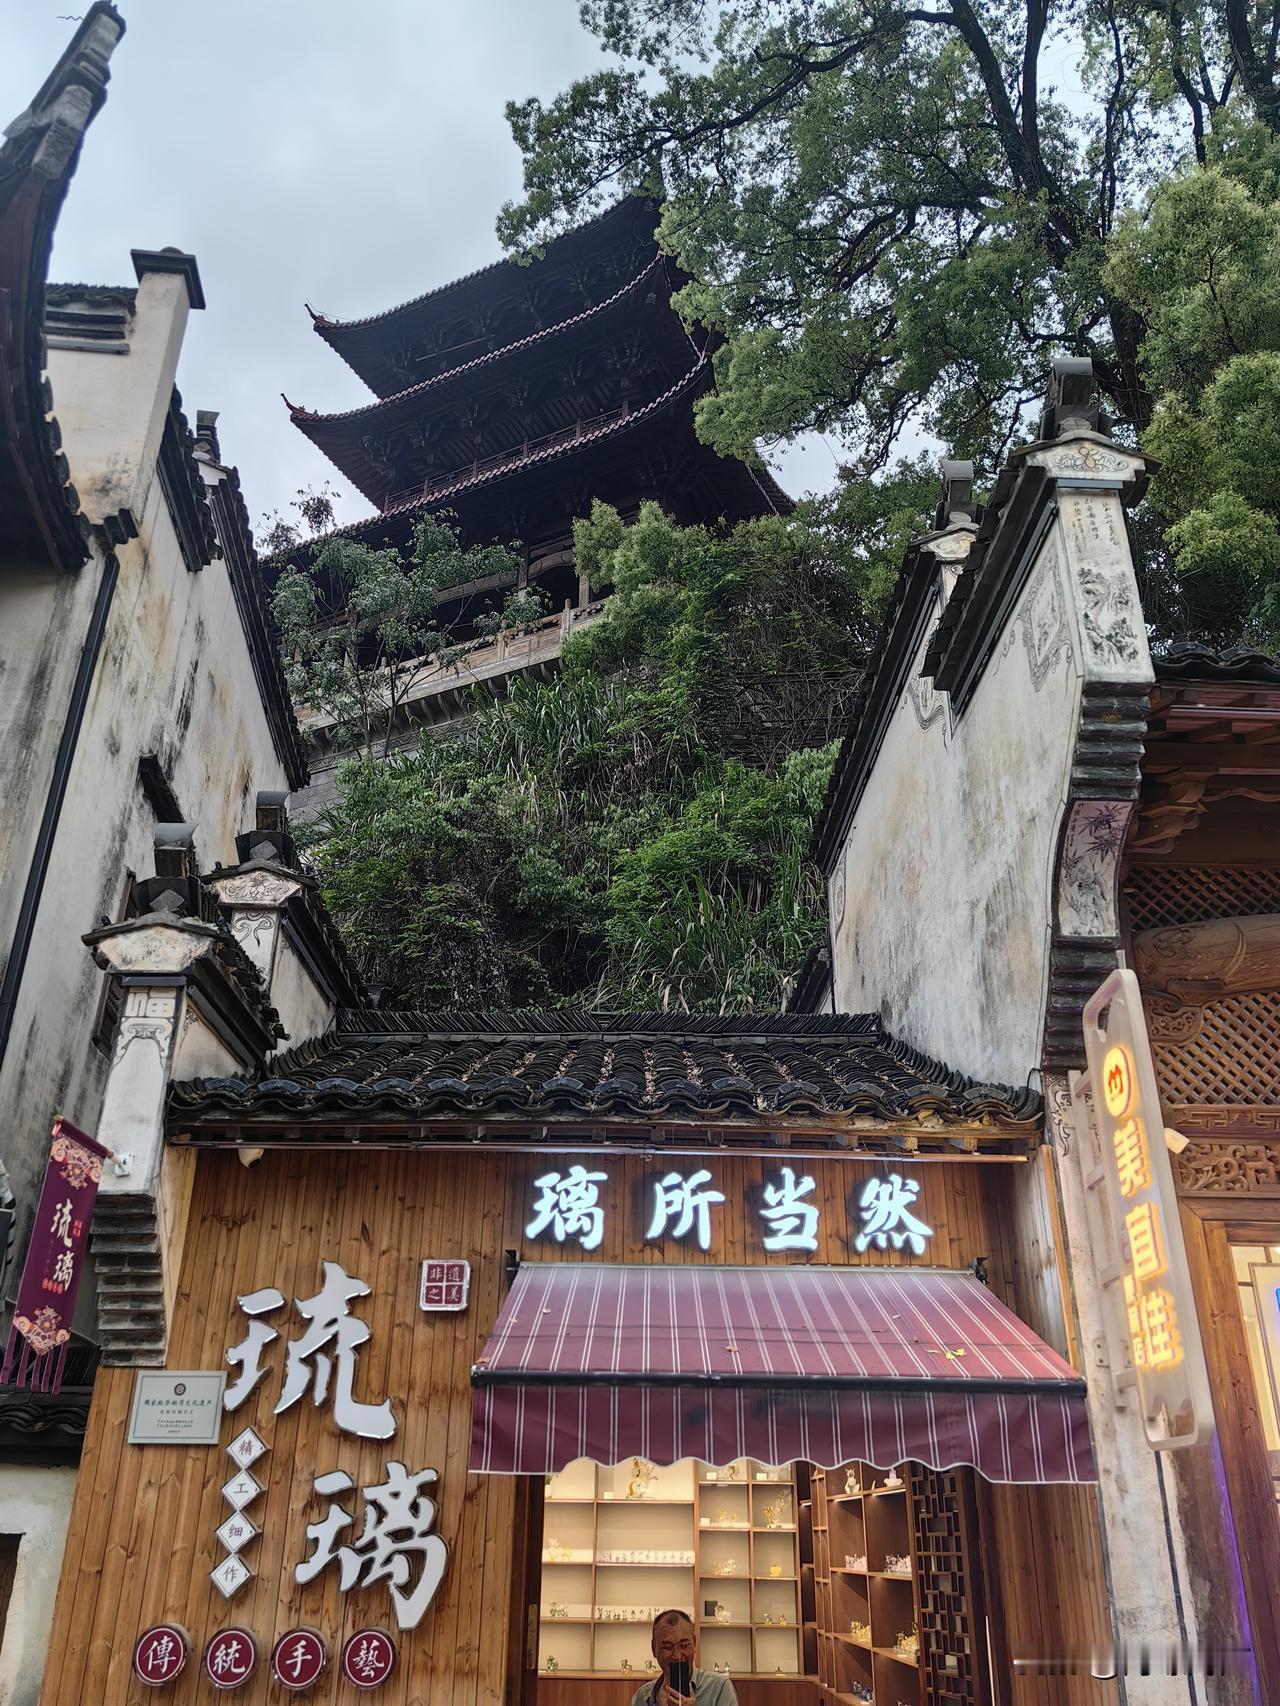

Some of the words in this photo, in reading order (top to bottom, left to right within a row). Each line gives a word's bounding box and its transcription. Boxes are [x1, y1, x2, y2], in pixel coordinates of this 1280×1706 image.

[50, 1198, 75, 1292] 琉璃
[525, 1165, 934, 1256] 璃所当然
[1113, 1118, 1175, 1367] 美宜佳
[223, 1261, 452, 1631] 琉璃
[222, 1439, 254, 1583] 精工细作
[143, 1635, 385, 1679] 傳統手藝
